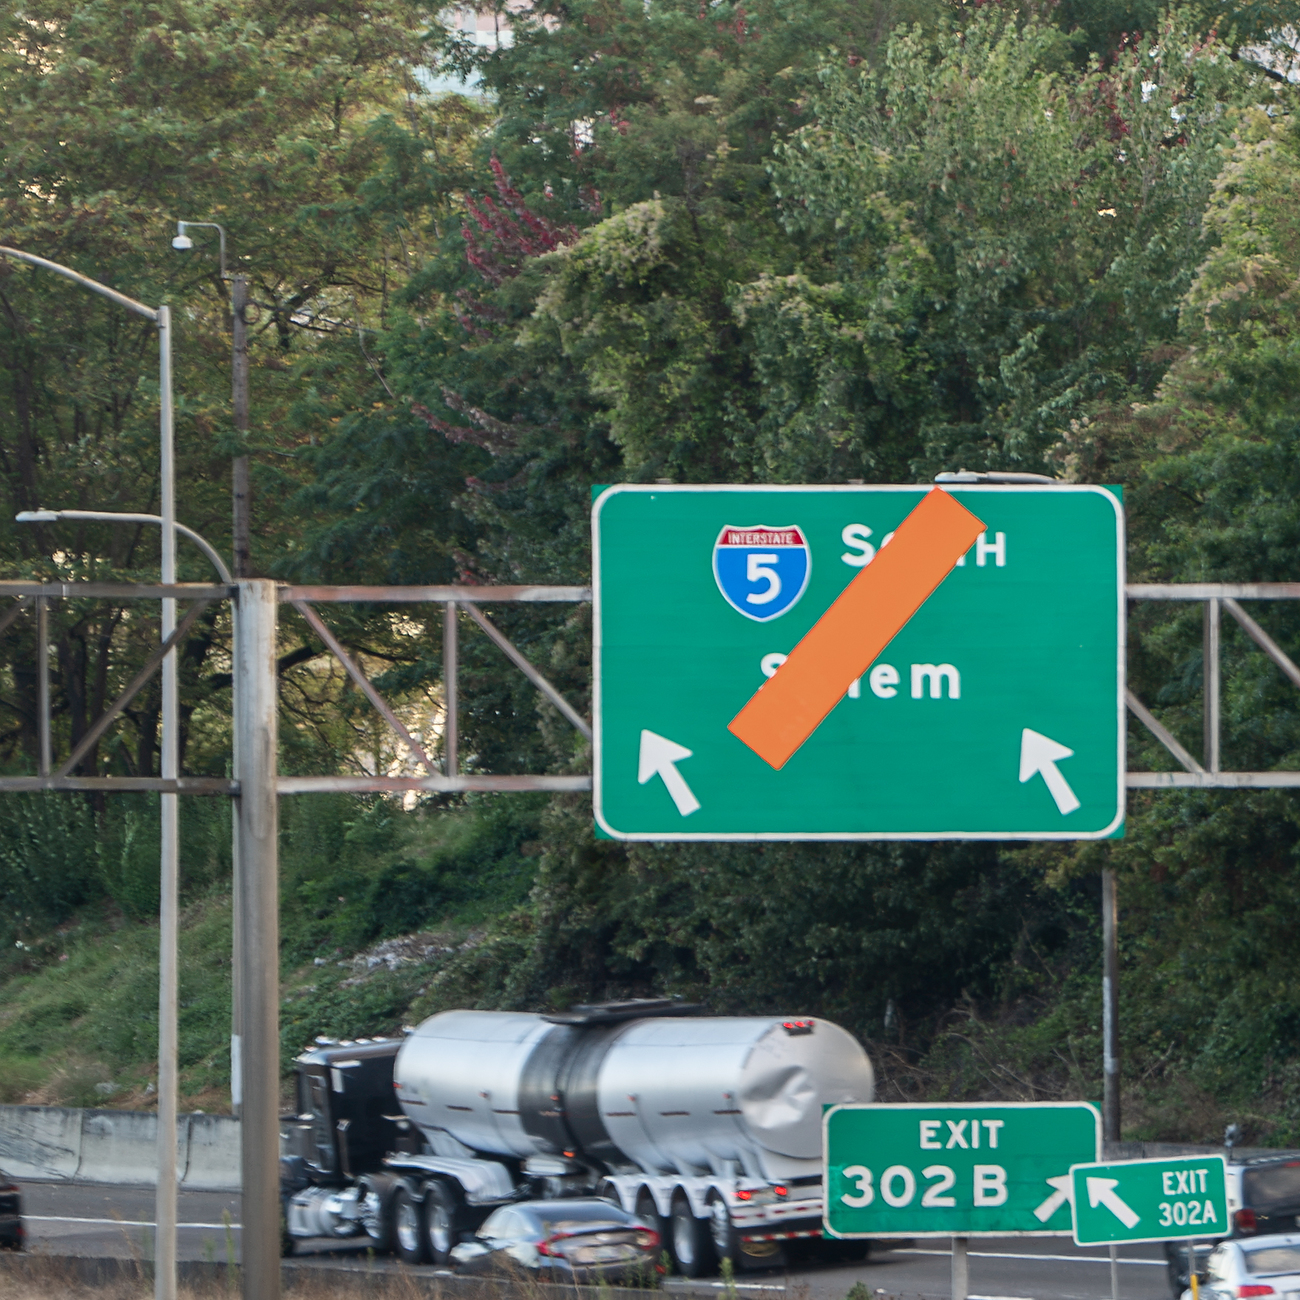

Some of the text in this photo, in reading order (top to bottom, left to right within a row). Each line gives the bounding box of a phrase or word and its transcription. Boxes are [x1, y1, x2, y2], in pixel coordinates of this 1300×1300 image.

[727, 531, 794, 545] INTERSTATE
[745, 553, 782, 605] 5
[919, 1119, 1005, 1150] EXIT
[1162, 1168, 1210, 1197] EXIT
[1158, 1199, 1218, 1227] 302A
